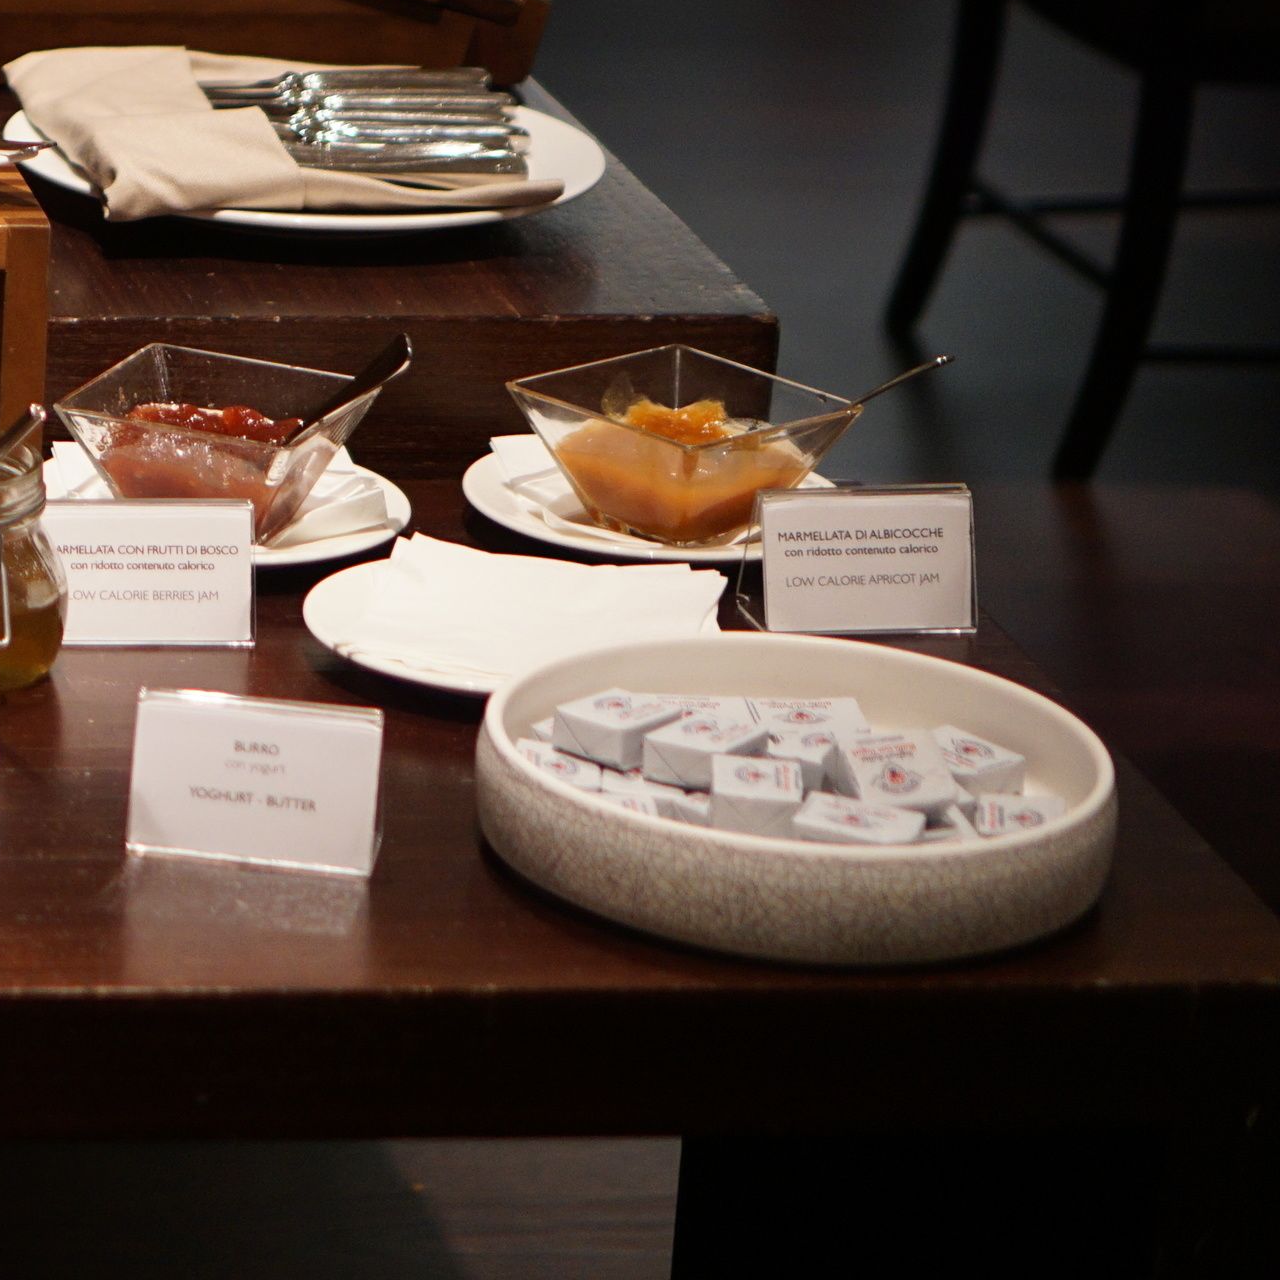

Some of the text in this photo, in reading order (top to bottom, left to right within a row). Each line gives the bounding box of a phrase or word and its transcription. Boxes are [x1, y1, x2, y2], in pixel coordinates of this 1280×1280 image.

[778, 527, 944, 543] MARMELLATA DI ALBICOCCHE
[56, 544, 239, 556] ARMELLATA CON FRUTTI DI BOSCO
[784, 544, 939, 558] con ridotto contenuto calorico
[70, 559, 216, 570] con ridotto contenuto calorico
[785, 573, 940, 588] LOW CALORIE APRICOT JAM
[99, 589, 150, 601] CALORIE
[152, 589, 195, 601] BERRIES
[197, 589, 219, 603] JAM
[233, 739, 281, 756] BURRO
[189, 784, 254, 805] YOGHURT
[265, 793, 317, 813] BUTTER
